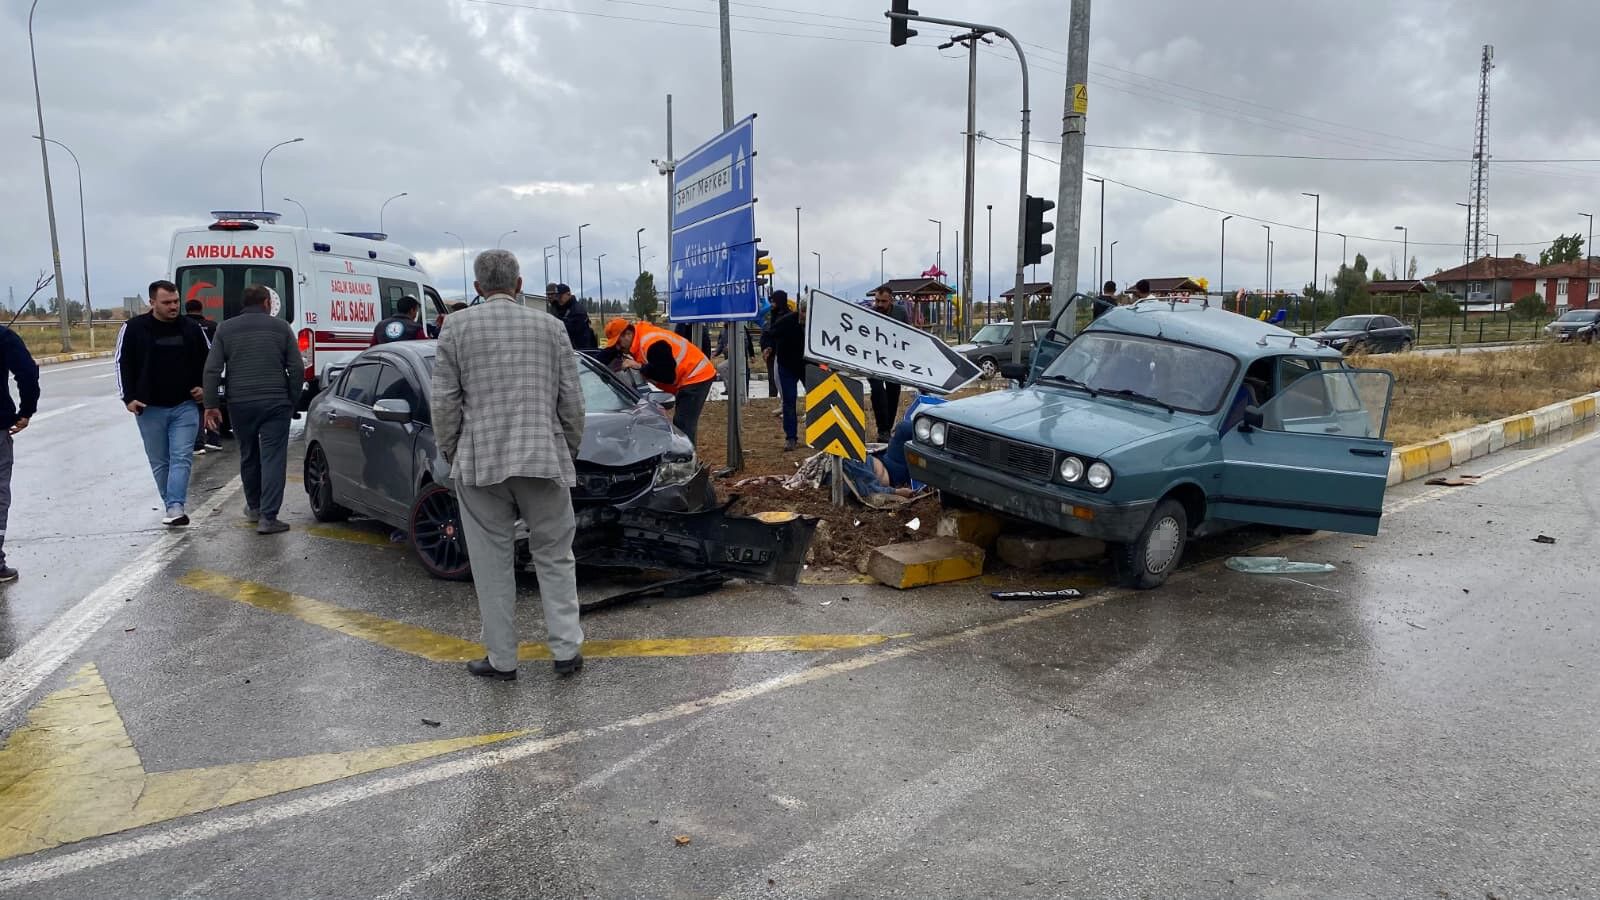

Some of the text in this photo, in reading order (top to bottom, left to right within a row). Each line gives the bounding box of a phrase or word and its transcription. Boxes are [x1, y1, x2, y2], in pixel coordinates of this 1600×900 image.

[186, 245, 275, 259] AMBULANS
[685, 241, 728, 268] Kütahya
[305, 311, 317, 324] 112
[349, 299, 376, 322] SAĞLIK
[840, 311, 911, 352] Şehir
